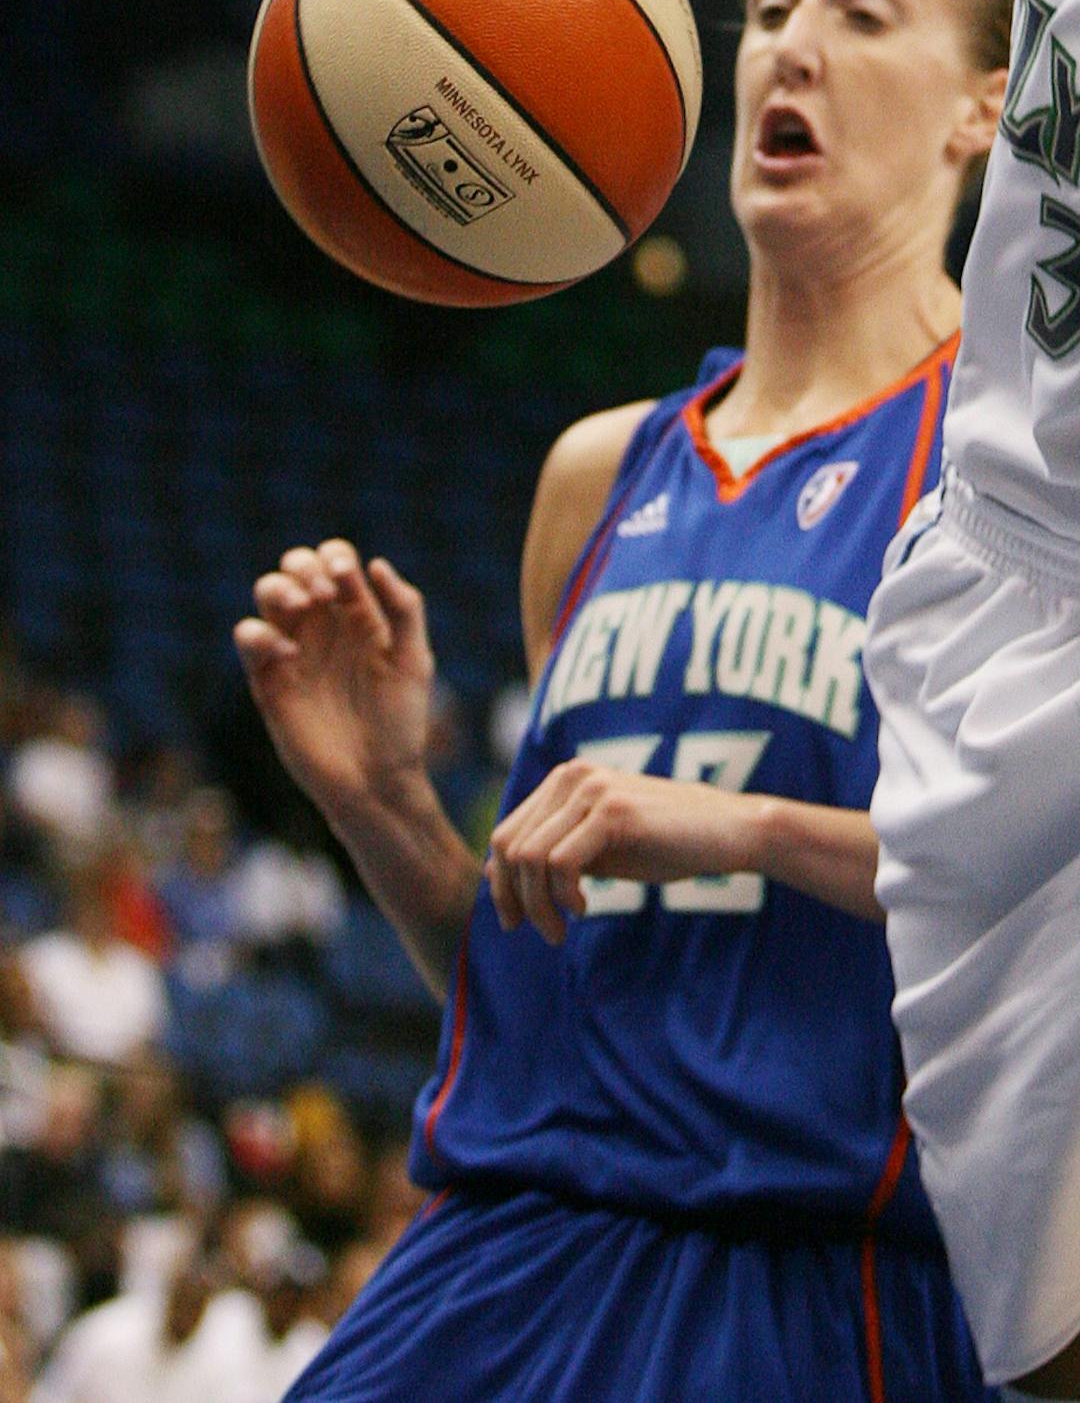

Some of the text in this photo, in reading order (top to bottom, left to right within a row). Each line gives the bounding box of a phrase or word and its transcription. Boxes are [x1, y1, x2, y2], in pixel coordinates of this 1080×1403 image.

[435, 76, 541, 185] MINNESOTA LYNX
[539, 580, 869, 741] NEW YORK
